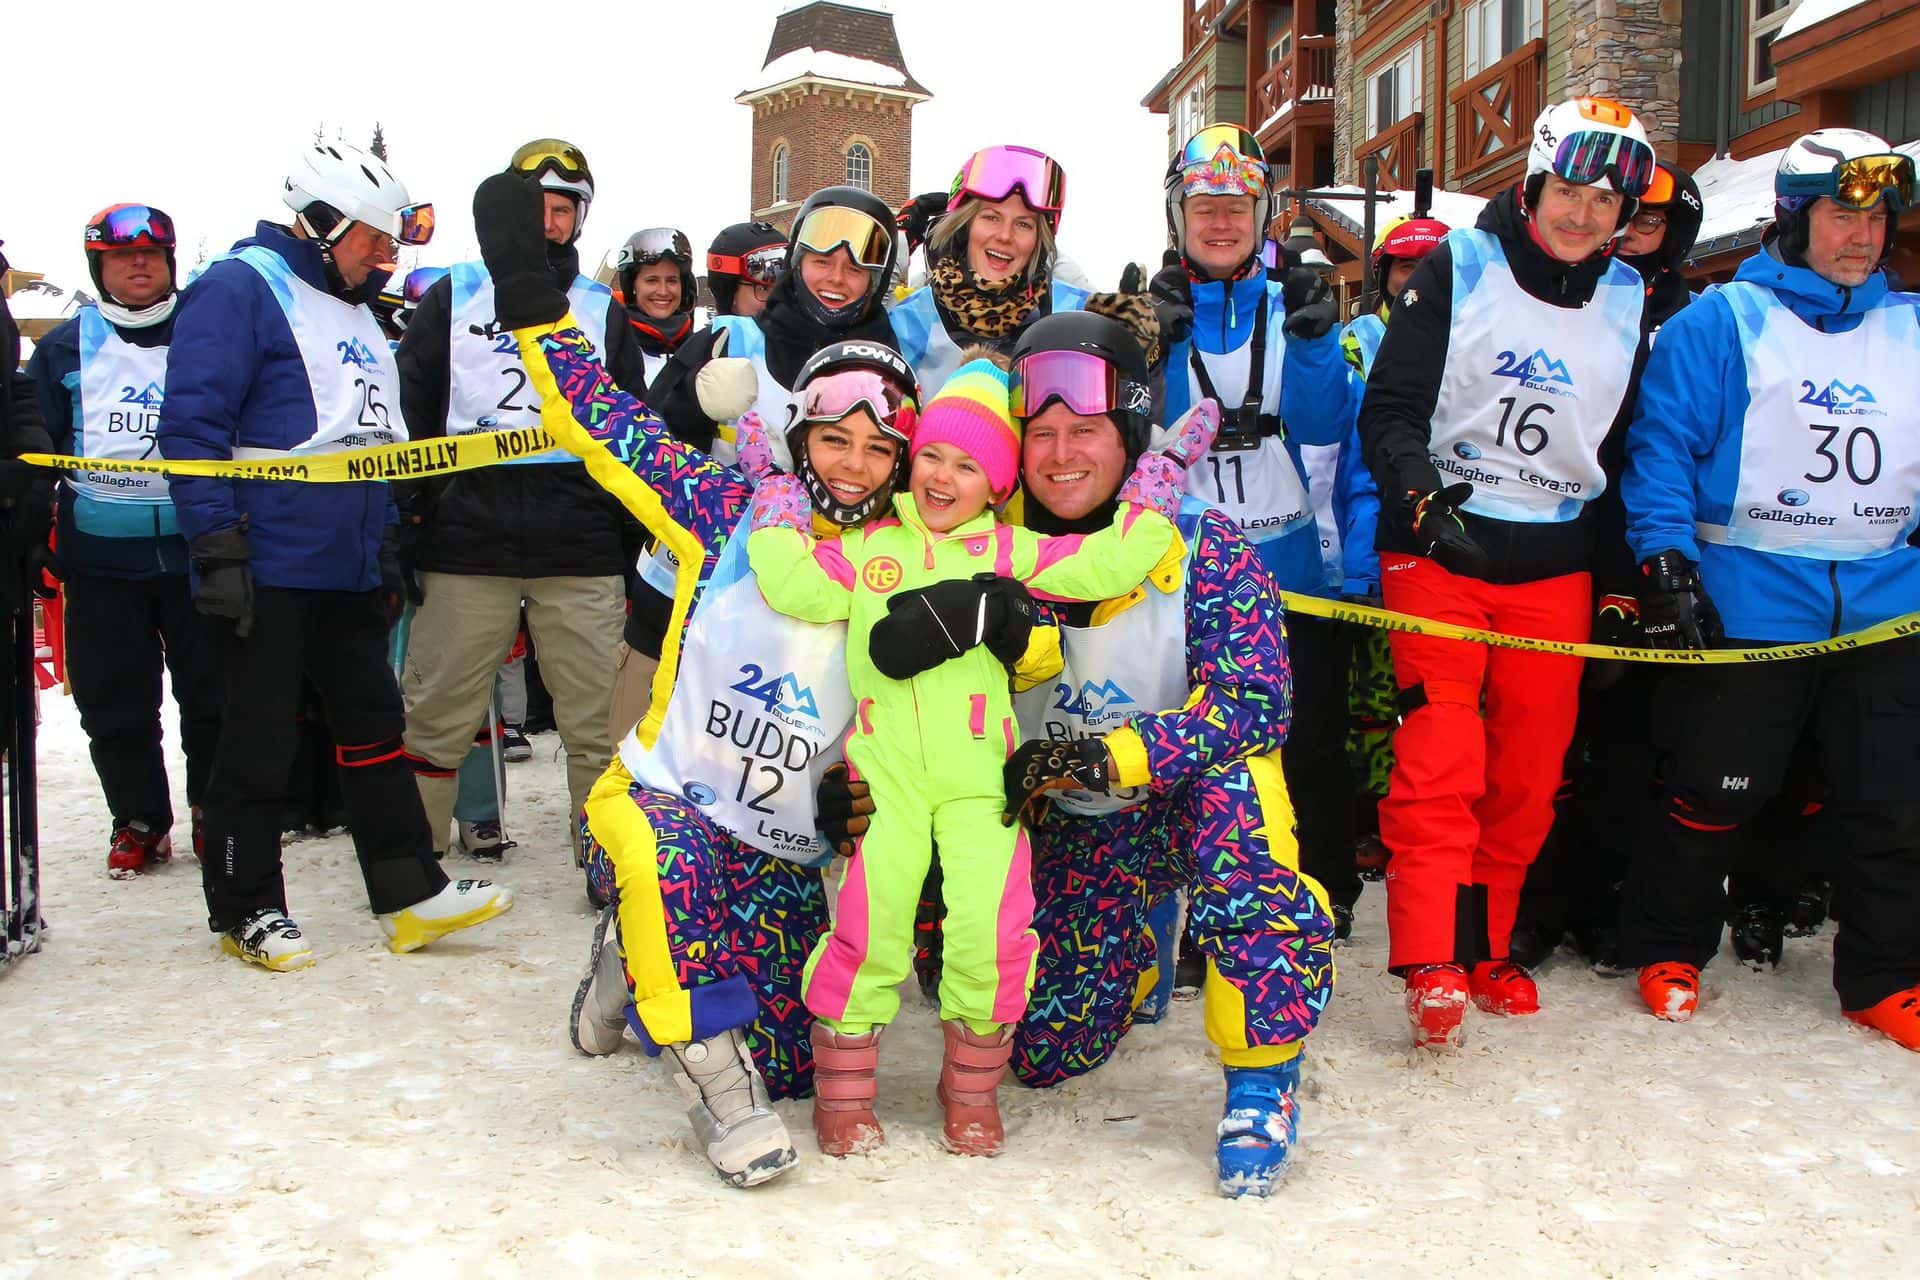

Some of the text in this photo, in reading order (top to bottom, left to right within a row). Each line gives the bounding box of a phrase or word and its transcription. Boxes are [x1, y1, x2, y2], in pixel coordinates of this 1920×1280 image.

[842, 345, 893, 363] POW
[108, 412, 161, 433] BUD
[354, 378, 392, 430] 26
[1496, 397, 1556, 456] 16
[347, 441, 459, 480] ATTENTION
[1429, 453, 1503, 486] Gallagher
[1804, 424, 1882, 486] 30
[87, 472, 151, 488] Gallagher
[1207, 455, 1246, 504] 11
[1748, 507, 1838, 527] Gallagher
[1644, 623, 1677, 634] AUCLAIR
[705, 699, 820, 773] BUDD
[735, 756, 785, 816] 12
